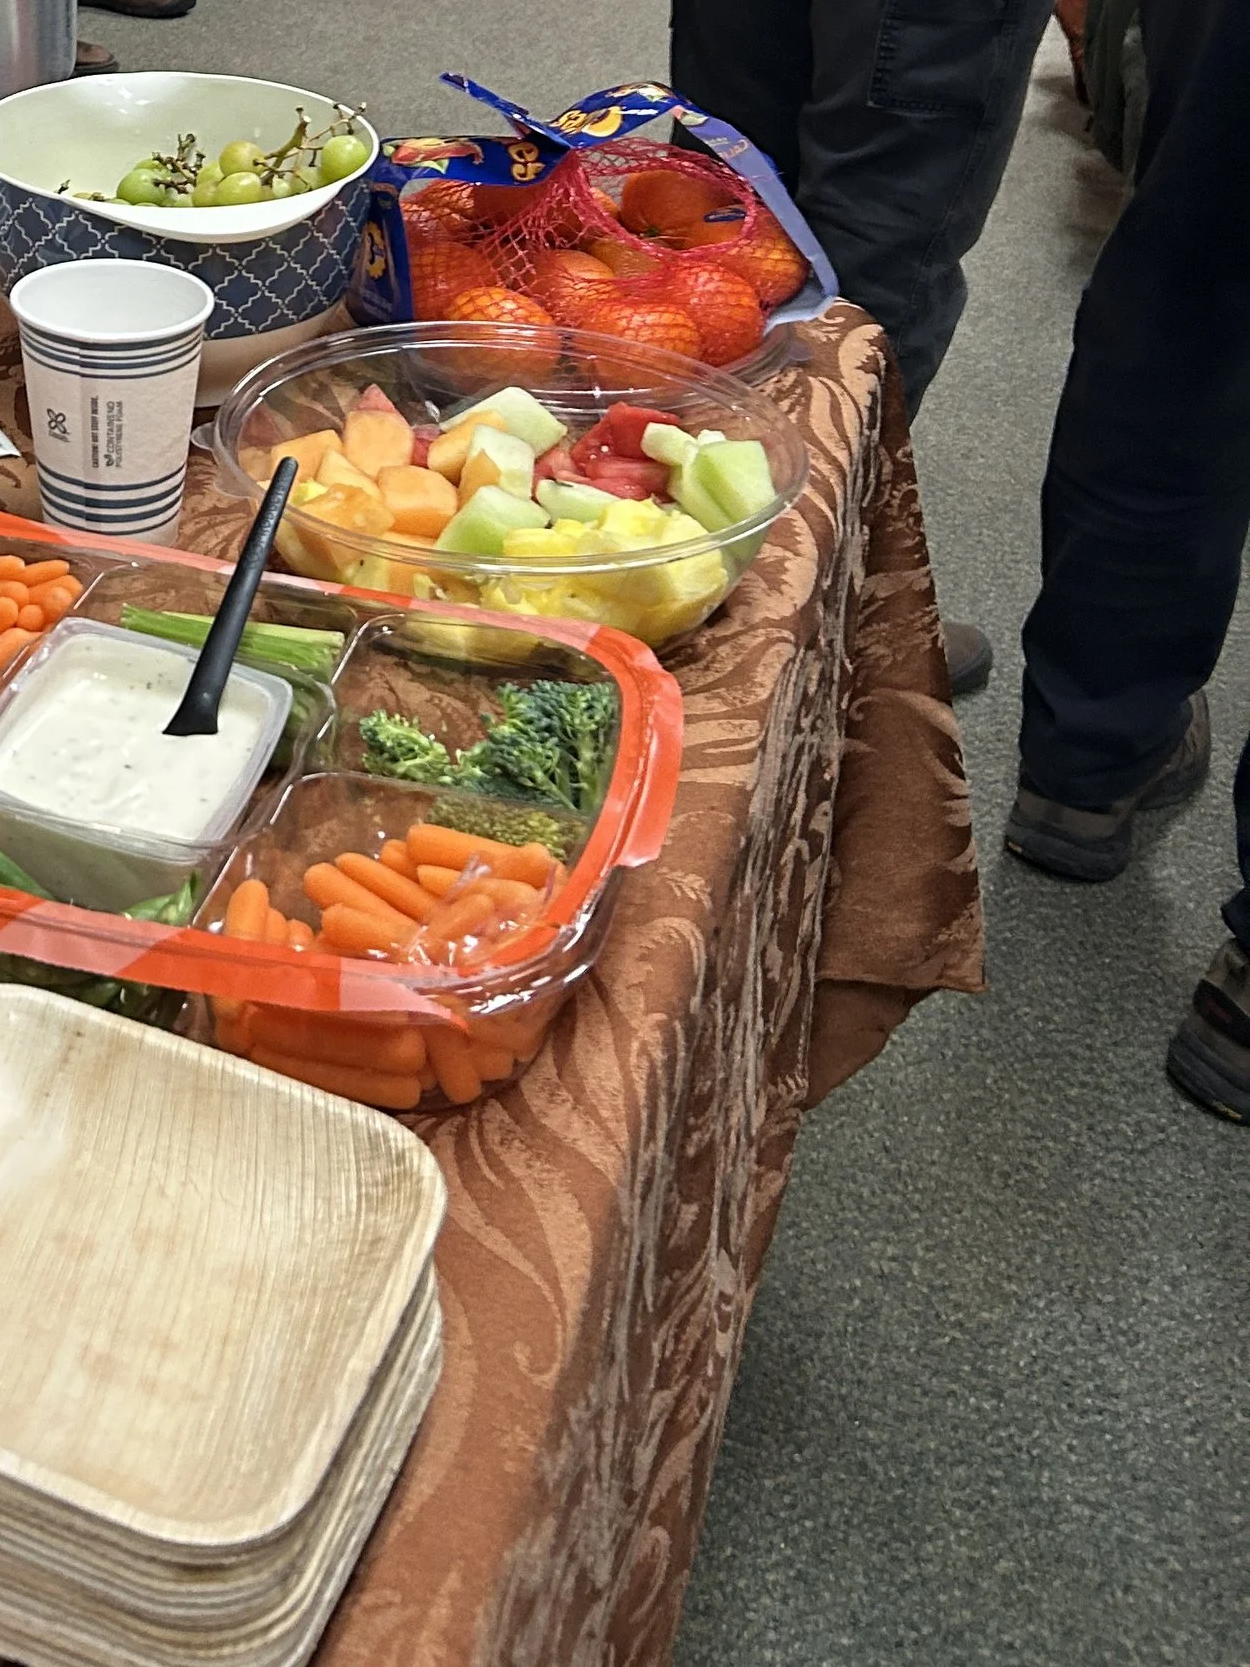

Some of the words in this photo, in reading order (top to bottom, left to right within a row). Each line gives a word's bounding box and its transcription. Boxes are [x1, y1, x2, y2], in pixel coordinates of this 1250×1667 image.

[107, 401, 115, 415] NO
[115, 401, 123, 422] FOAM
[107, 416, 115, 453] CONTAINS
